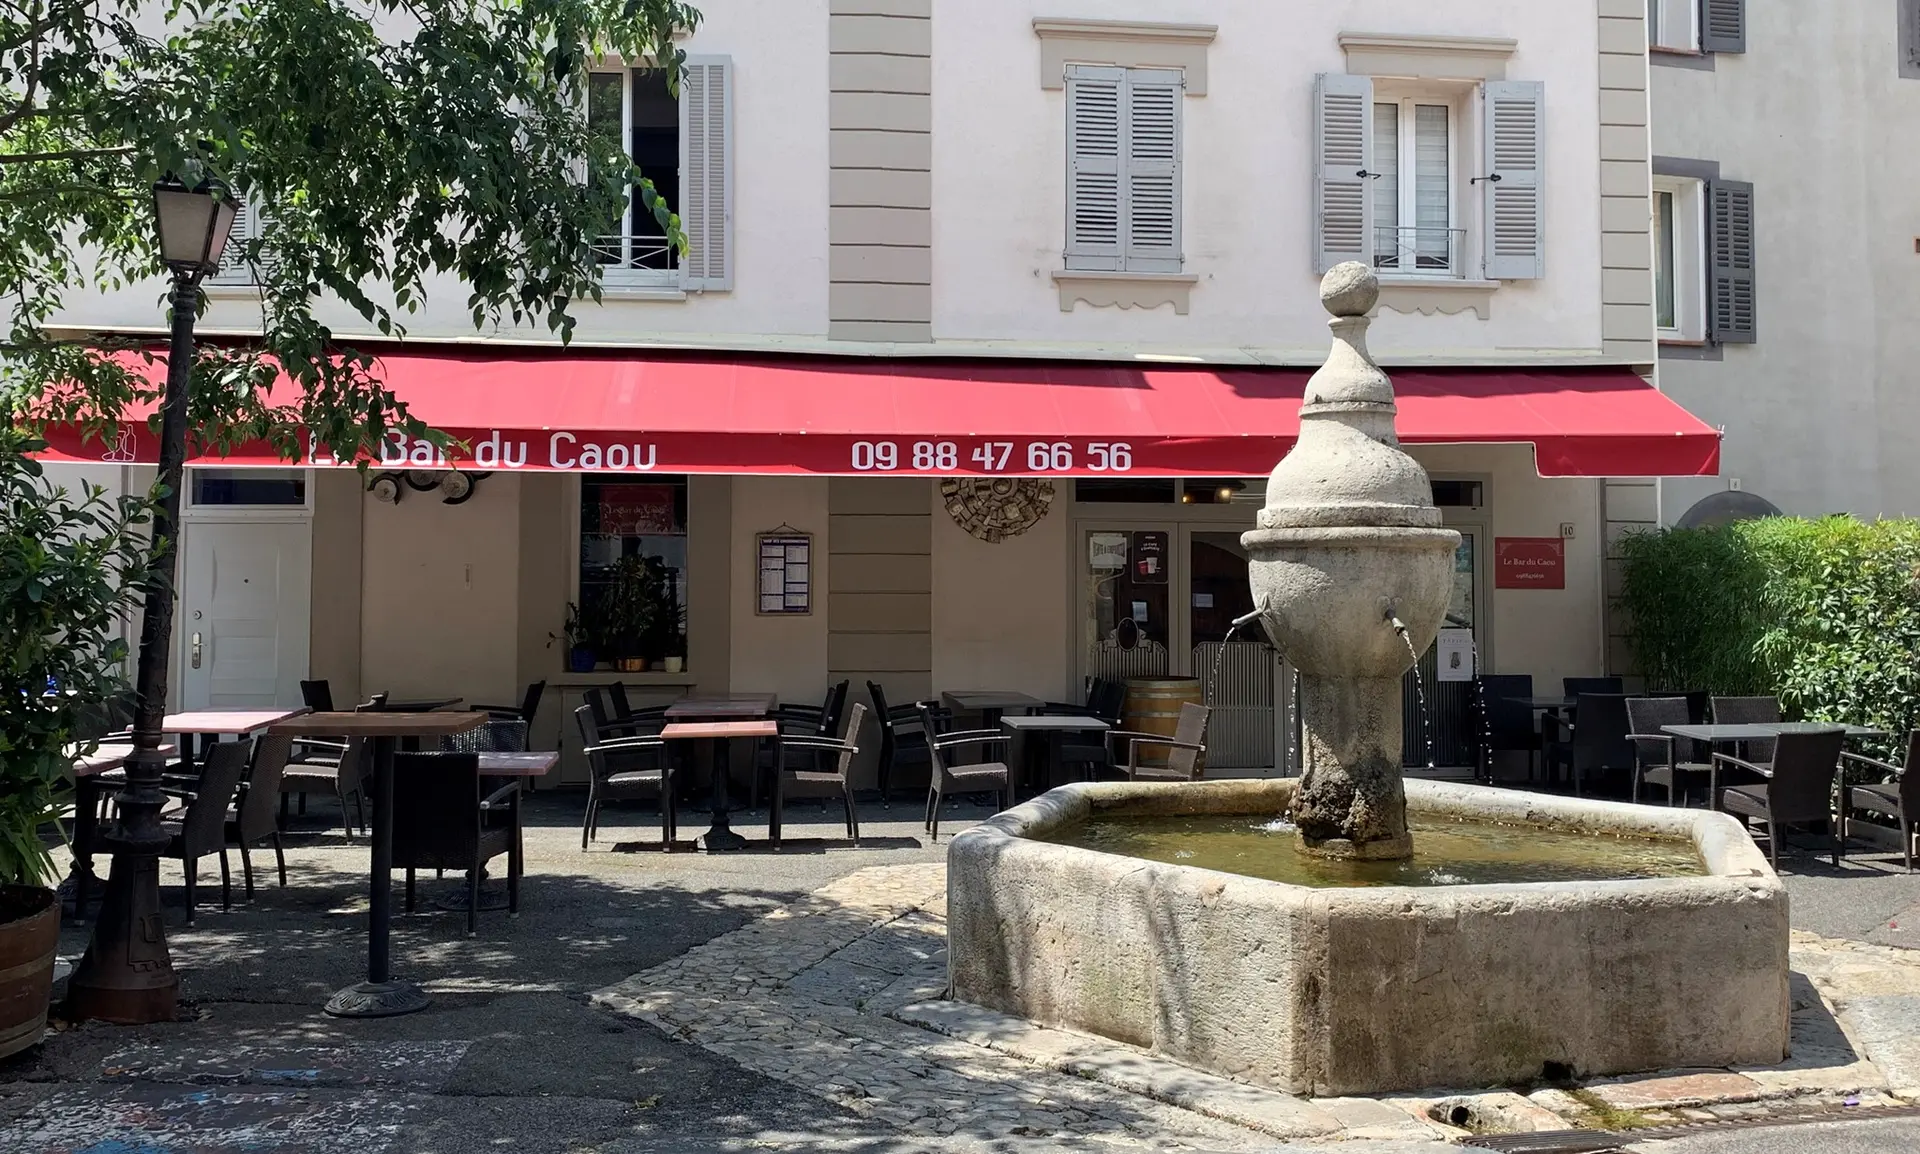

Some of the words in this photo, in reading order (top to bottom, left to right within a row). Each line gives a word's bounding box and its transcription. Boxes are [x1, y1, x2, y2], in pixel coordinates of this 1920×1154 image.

[475, 431, 527, 467] du
[549, 432, 656, 470] Caou
[851, 441, 898, 471] 09
[912, 441, 958, 471] 88
[971, 442, 1014, 471] 47
[1027, 442, 1073, 471] 66
[1086, 442, 1132, 471] 56
[1564, 526, 1574, 536] 10
[1503, 558, 1512, 566] Le
[1513, 558, 1525, 566] Bar
[1526, 558, 1536, 566] du
